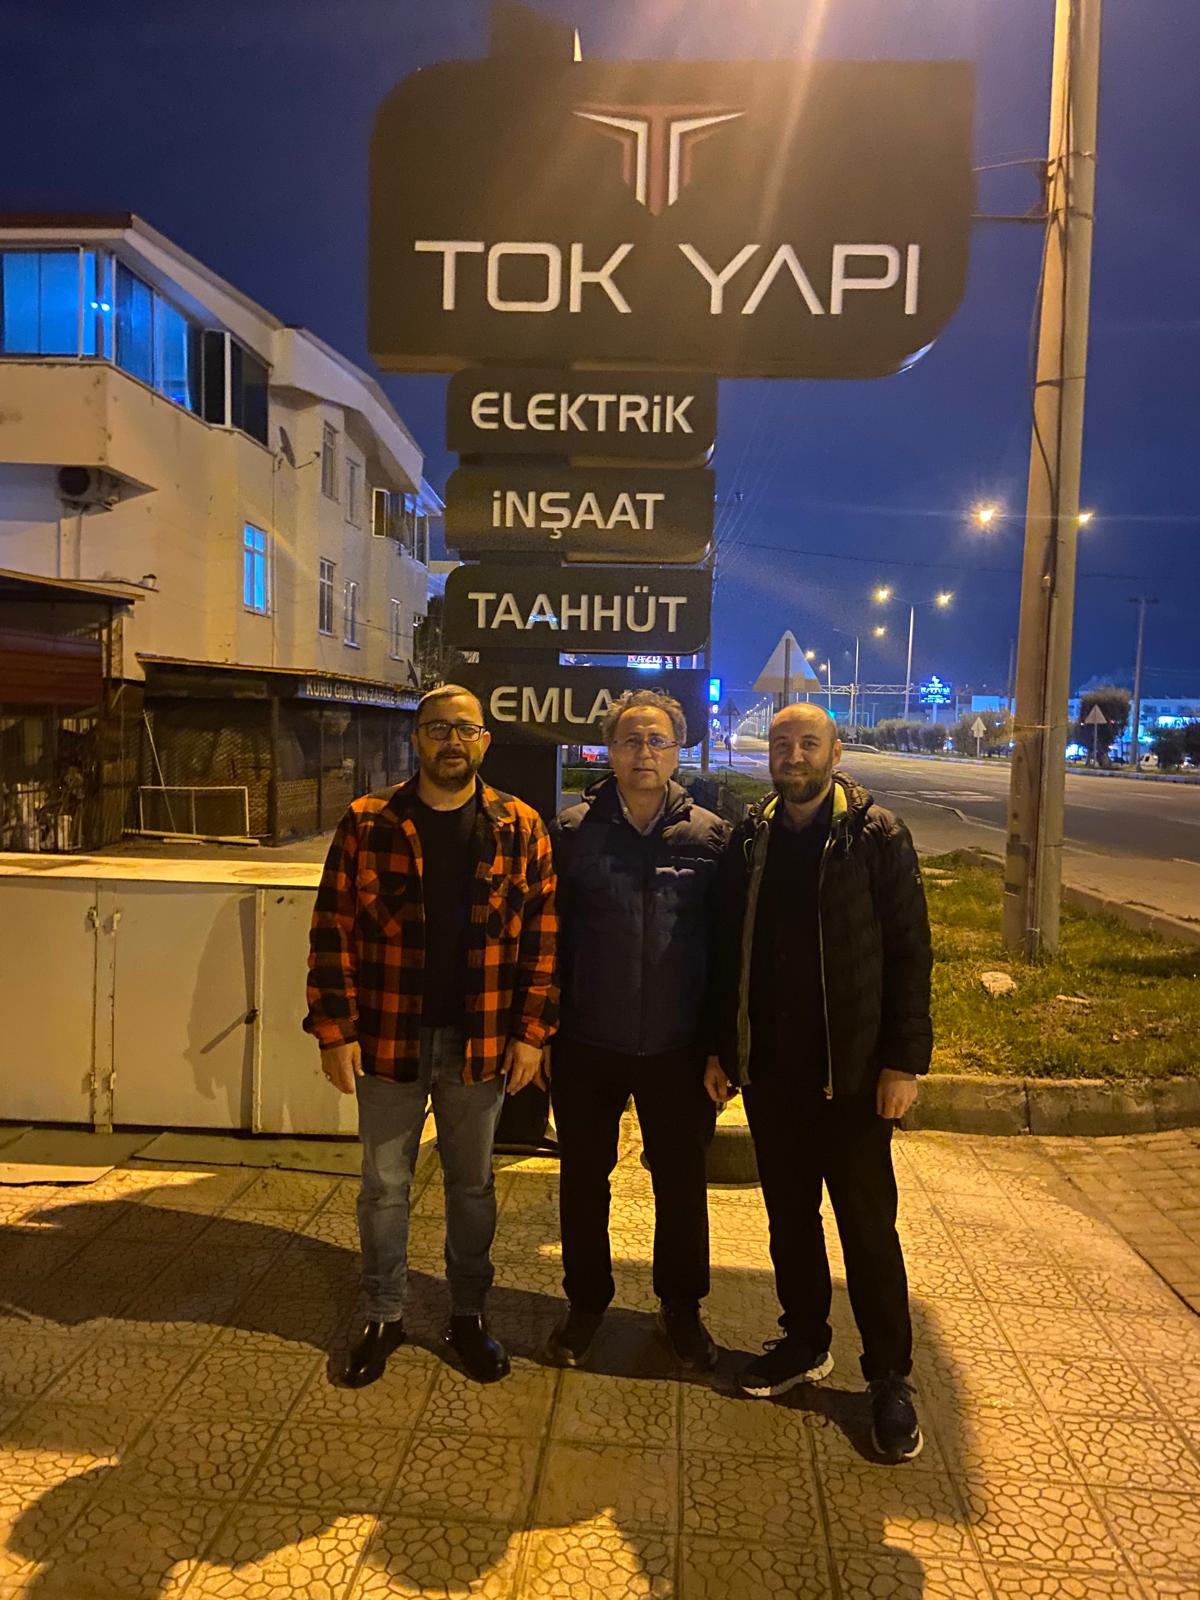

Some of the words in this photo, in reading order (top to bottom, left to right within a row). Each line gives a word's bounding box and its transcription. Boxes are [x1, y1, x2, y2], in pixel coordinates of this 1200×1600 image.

[414, 240, 634, 314] TOK
[678, 243, 920, 315] YAPI
[468, 586, 687, 633] TAAHHÜT
[489, 686, 613, 724] EMLA
